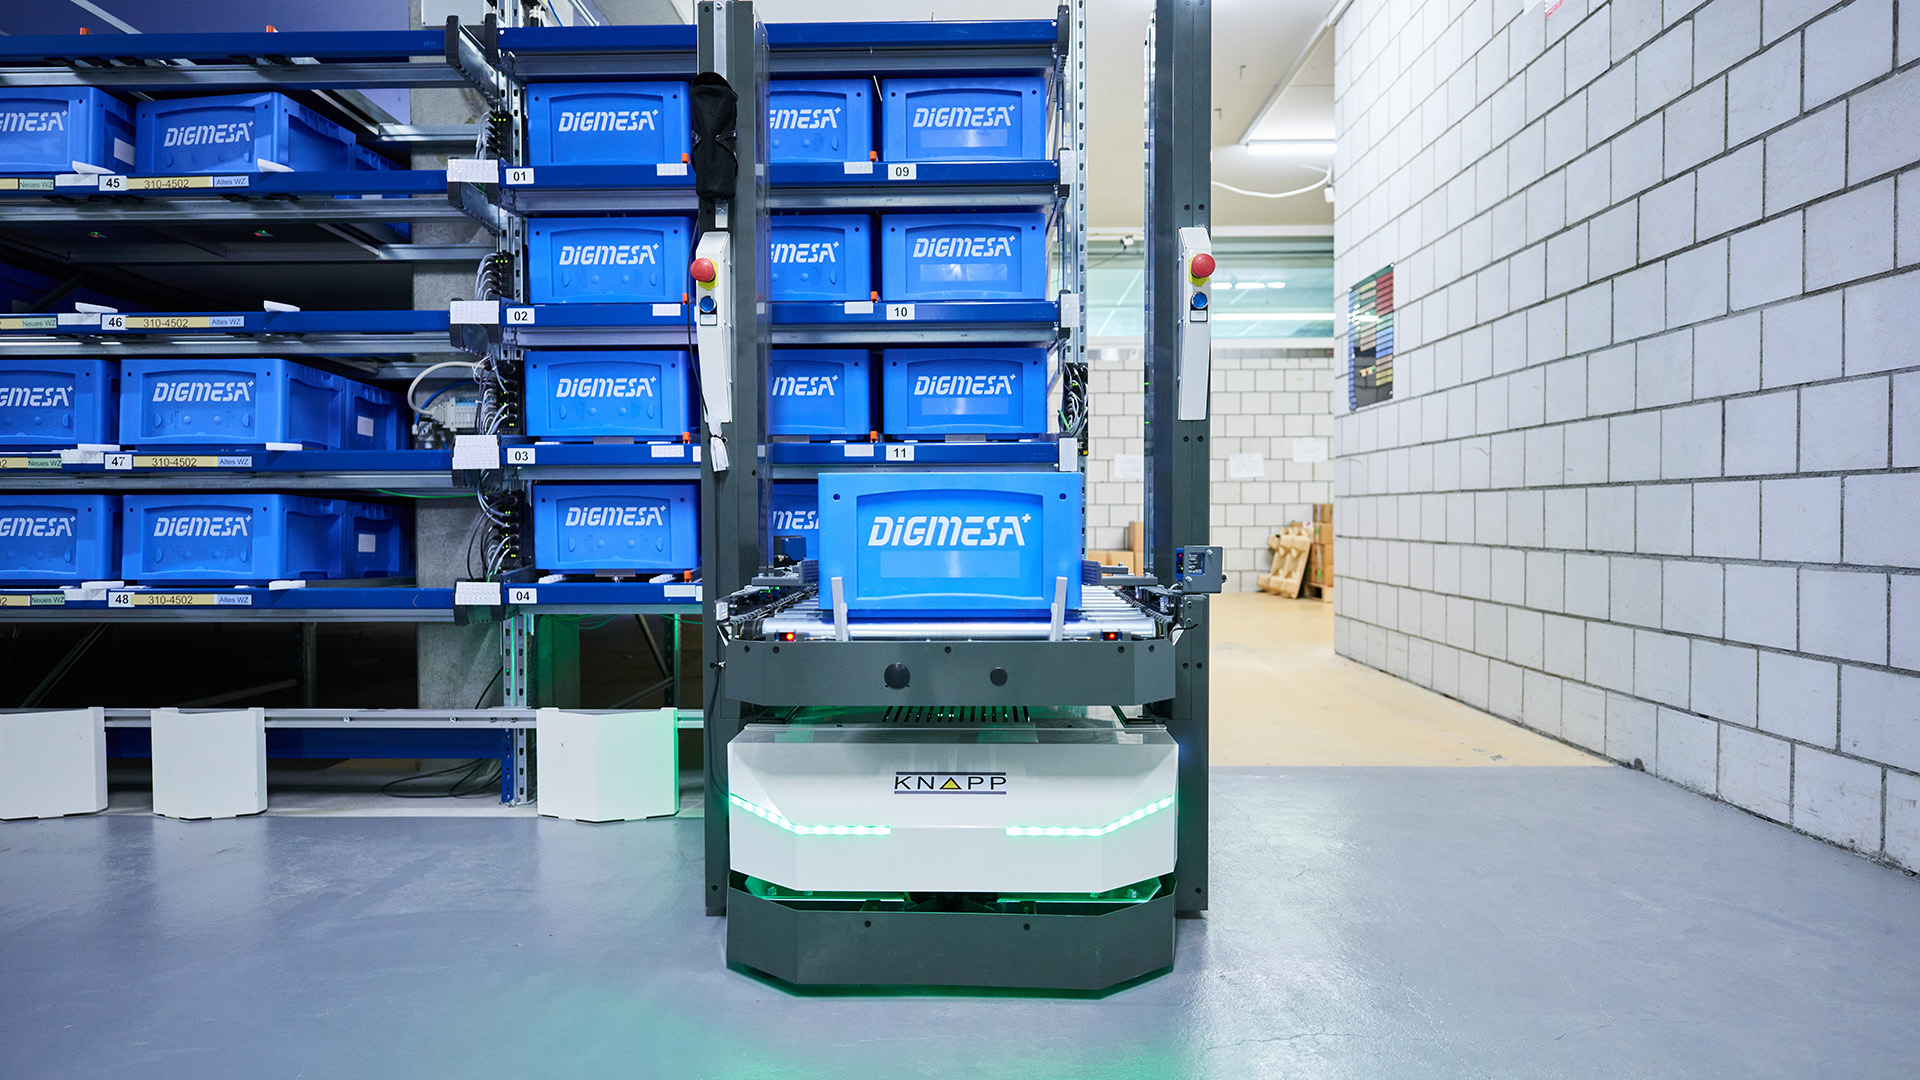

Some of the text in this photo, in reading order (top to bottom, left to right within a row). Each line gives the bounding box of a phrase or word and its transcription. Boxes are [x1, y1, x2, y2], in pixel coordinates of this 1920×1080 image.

[513, 171, 526, 182] 01
[895, 166, 910, 178] 09
[20, 181, 53, 189] Neues WZ
[106, 178, 120, 188] 45
[144, 178, 190, 190] 310-4502
[514, 310, 528, 322] 02
[894, 306, 909, 318] 10
[45, 319, 56, 327] WZ
[108, 317, 123, 328] 46
[143, 318, 189, 328] 310-4502
[211, 318, 228, 326] Altes
[515, 450, 529, 462] 03
[894, 447, 907, 459] 11
[111, 456, 125, 467] 47
[151, 458, 197, 467] 310-4502
[115, 594, 129, 605] 48
[148, 595, 193, 605] 310-4502
[516, 590, 530, 602] 04
[894, 776, 1007, 790] KNAPP
